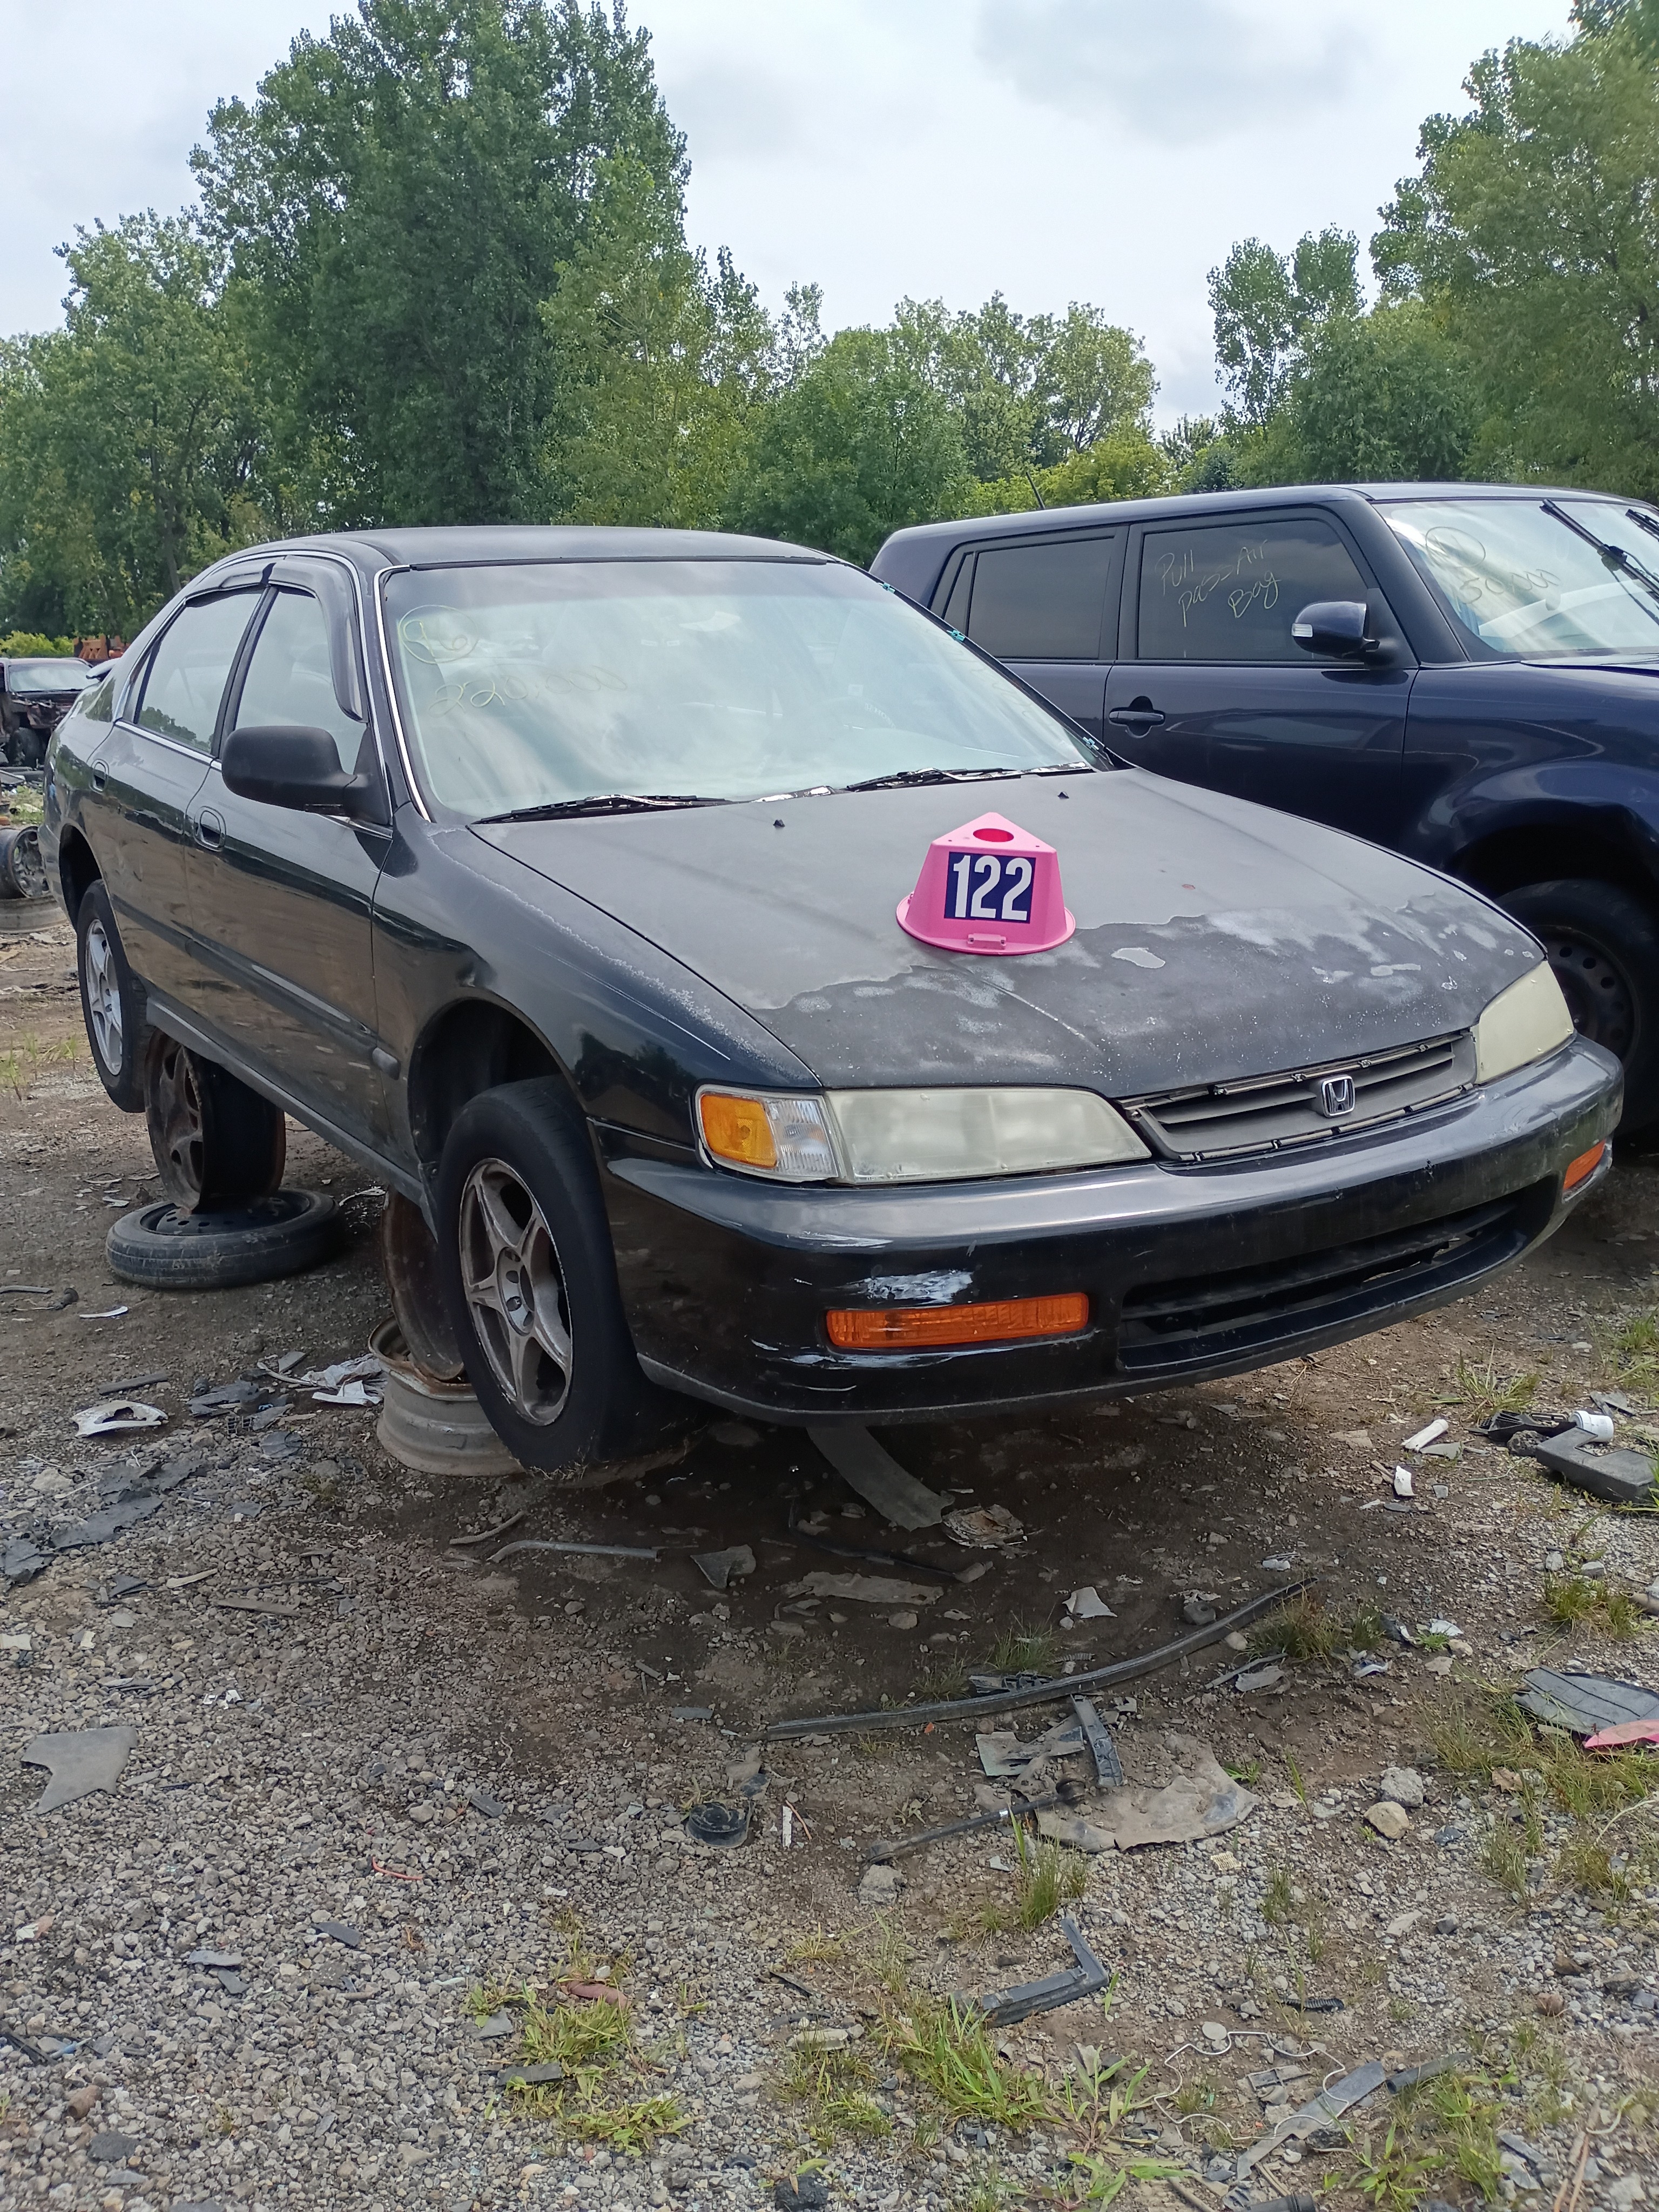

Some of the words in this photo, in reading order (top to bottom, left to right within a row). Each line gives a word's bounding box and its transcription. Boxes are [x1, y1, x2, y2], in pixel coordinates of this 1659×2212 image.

[1155, 549, 1193, 596] Pull
[1237, 539, 1268, 575] Air
[1228, 570, 1282, 618] Bag
[953, 854, 1033, 921] 122
